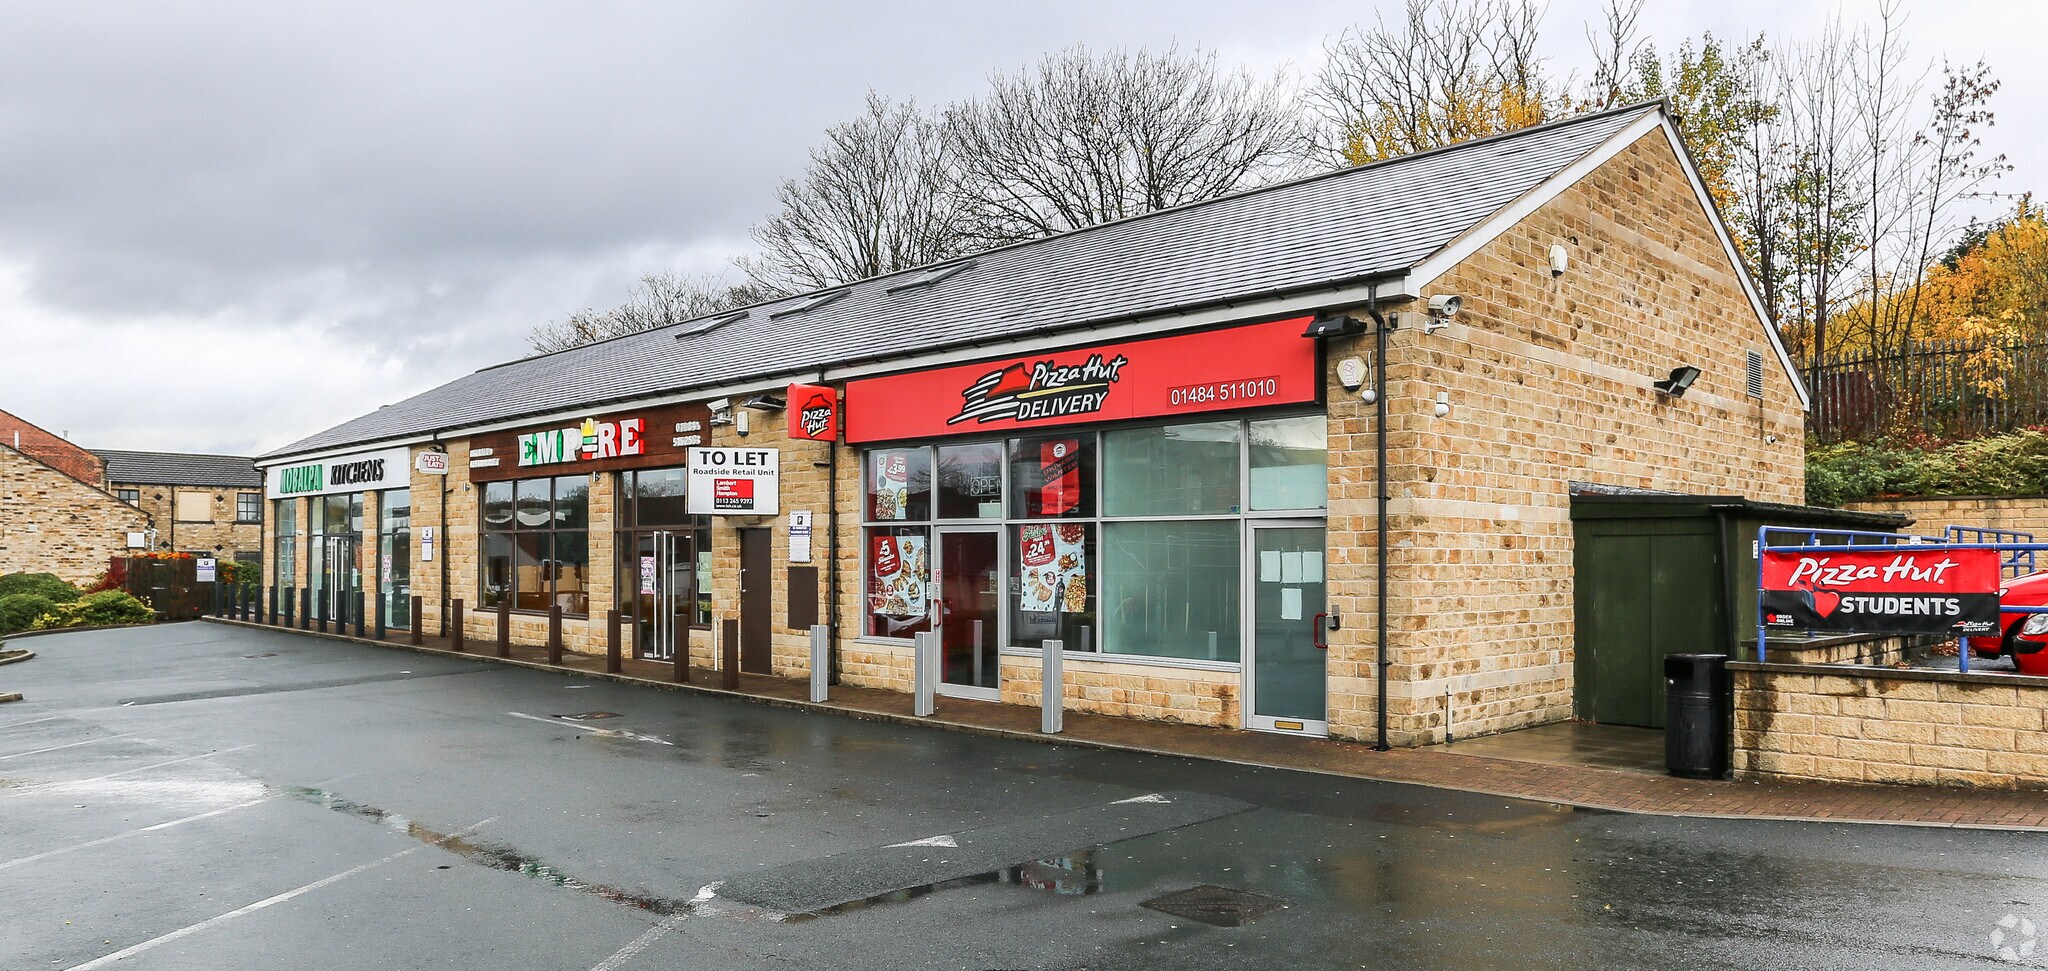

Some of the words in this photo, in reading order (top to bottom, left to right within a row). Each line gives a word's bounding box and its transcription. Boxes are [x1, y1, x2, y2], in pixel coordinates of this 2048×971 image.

[1029, 360, 1080, 391] Pizza
[1081, 355, 1127, 382] Hut
[1171, 385, 1215, 405] 01484
[1220, 379, 1276, 400] 511010
[1017, 391, 1108, 420] DELIVERY
[800, 408, 832, 429] Pizza
[806, 417, 829, 434] Hut
[699, 451, 727, 466] TO
[734, 451, 769, 466] LET
[1043, 454, 1075, 476] DRIVERS
[330, 458, 385, 486] KITCHENS
[1044, 460, 1078, 482] WANTED
[1788, 557, 1878, 587] Pizza
[1882, 555, 1959, 585] Hut
[1840, 597, 1960, 616] STUDENTS
